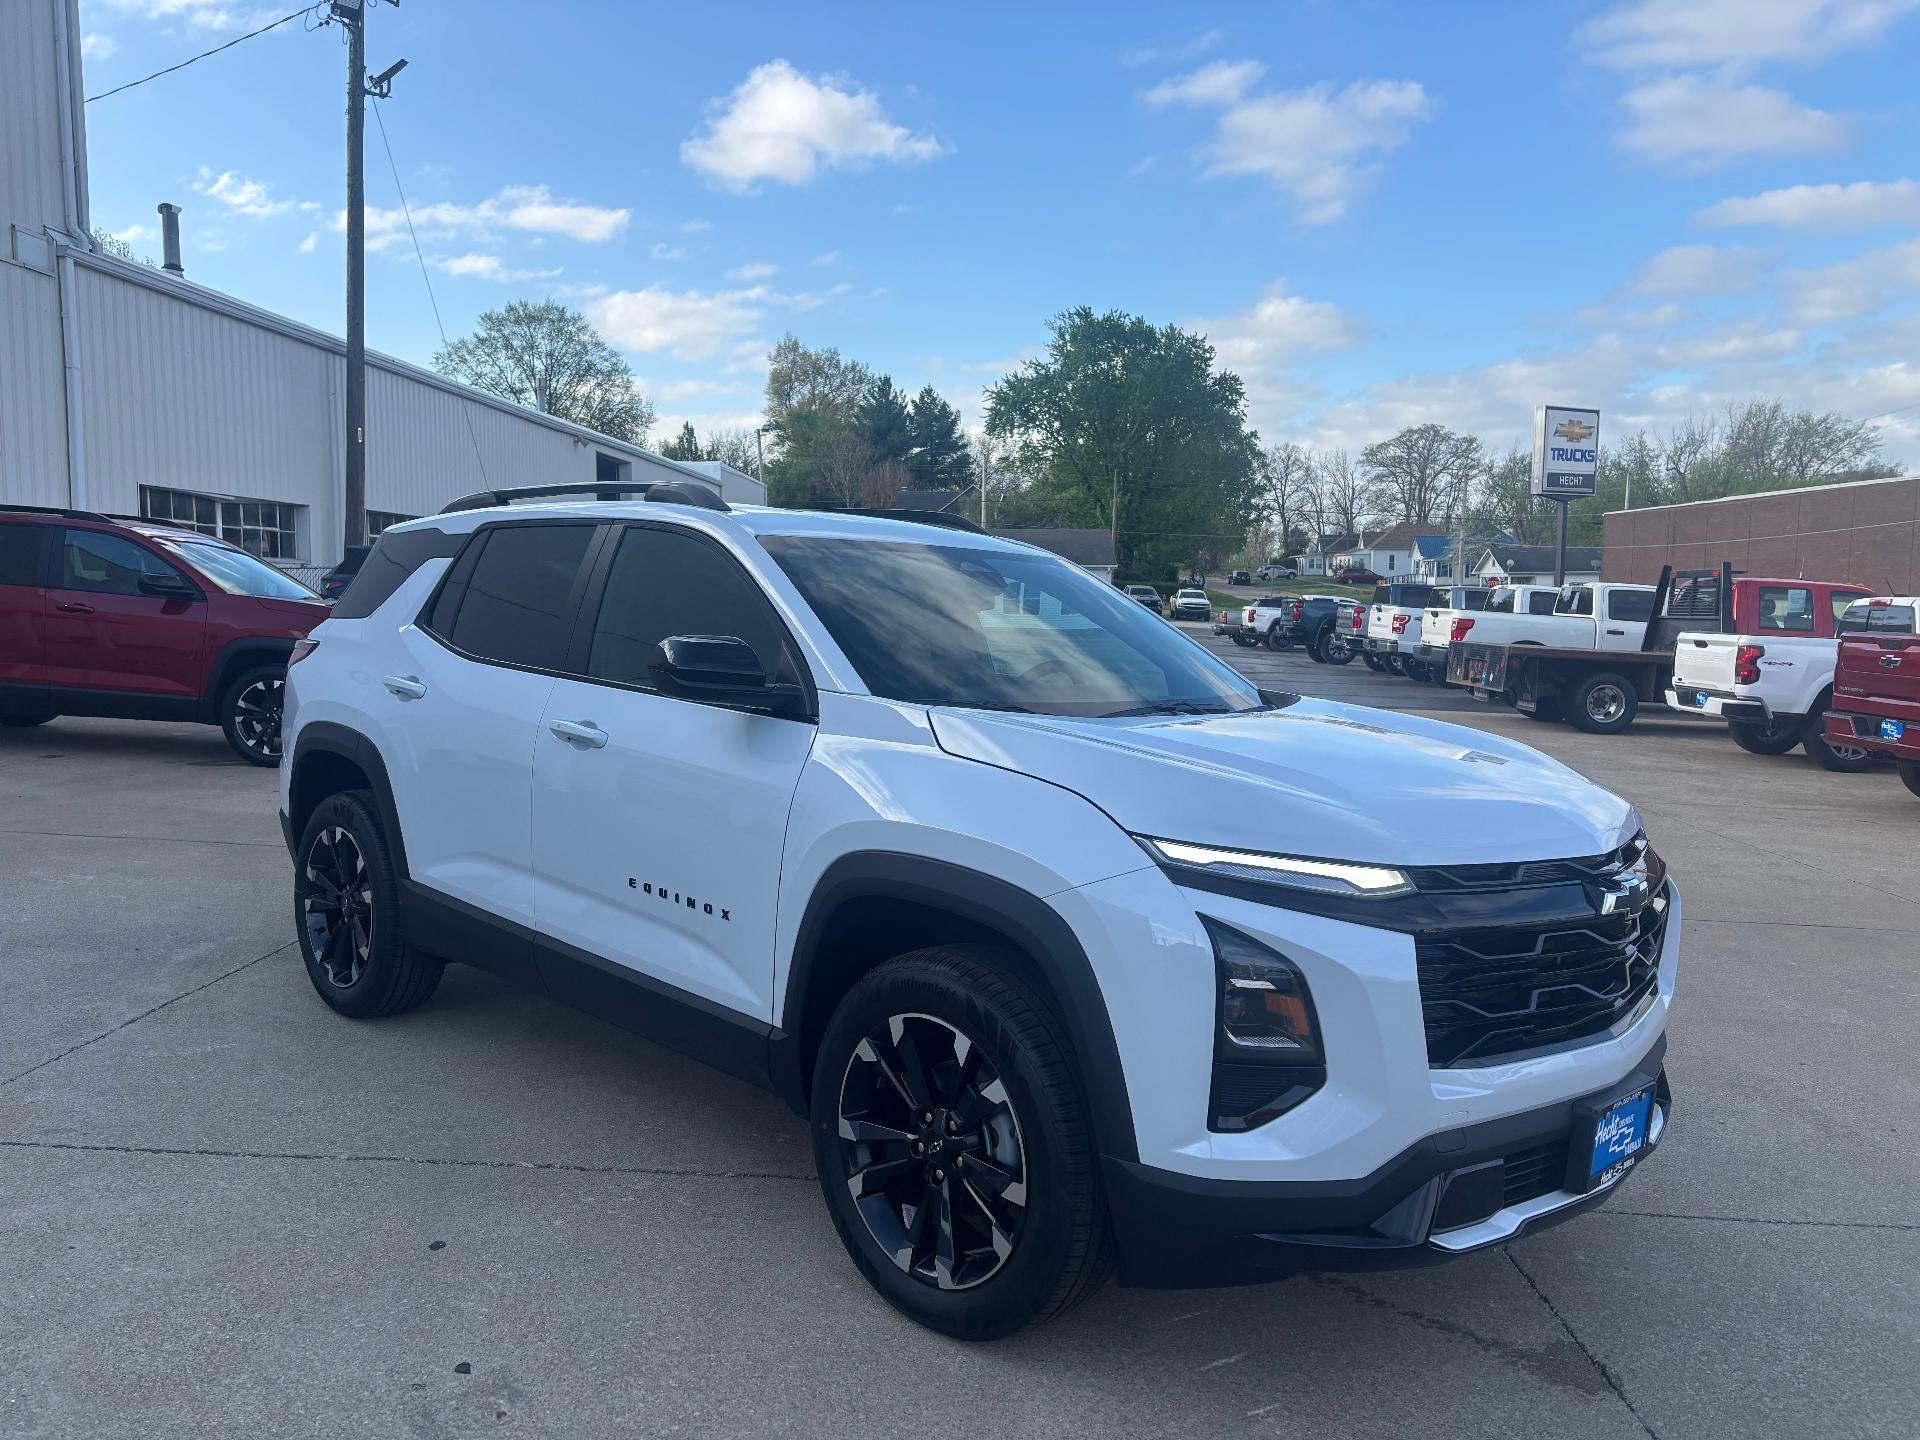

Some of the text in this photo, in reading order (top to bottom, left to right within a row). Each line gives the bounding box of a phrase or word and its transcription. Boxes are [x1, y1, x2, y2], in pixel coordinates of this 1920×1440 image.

[1551, 447, 1595, 463] TRUCKS
[1559, 475, 1583, 486] HECHT
[628, 877, 731, 922] EQUINOX
